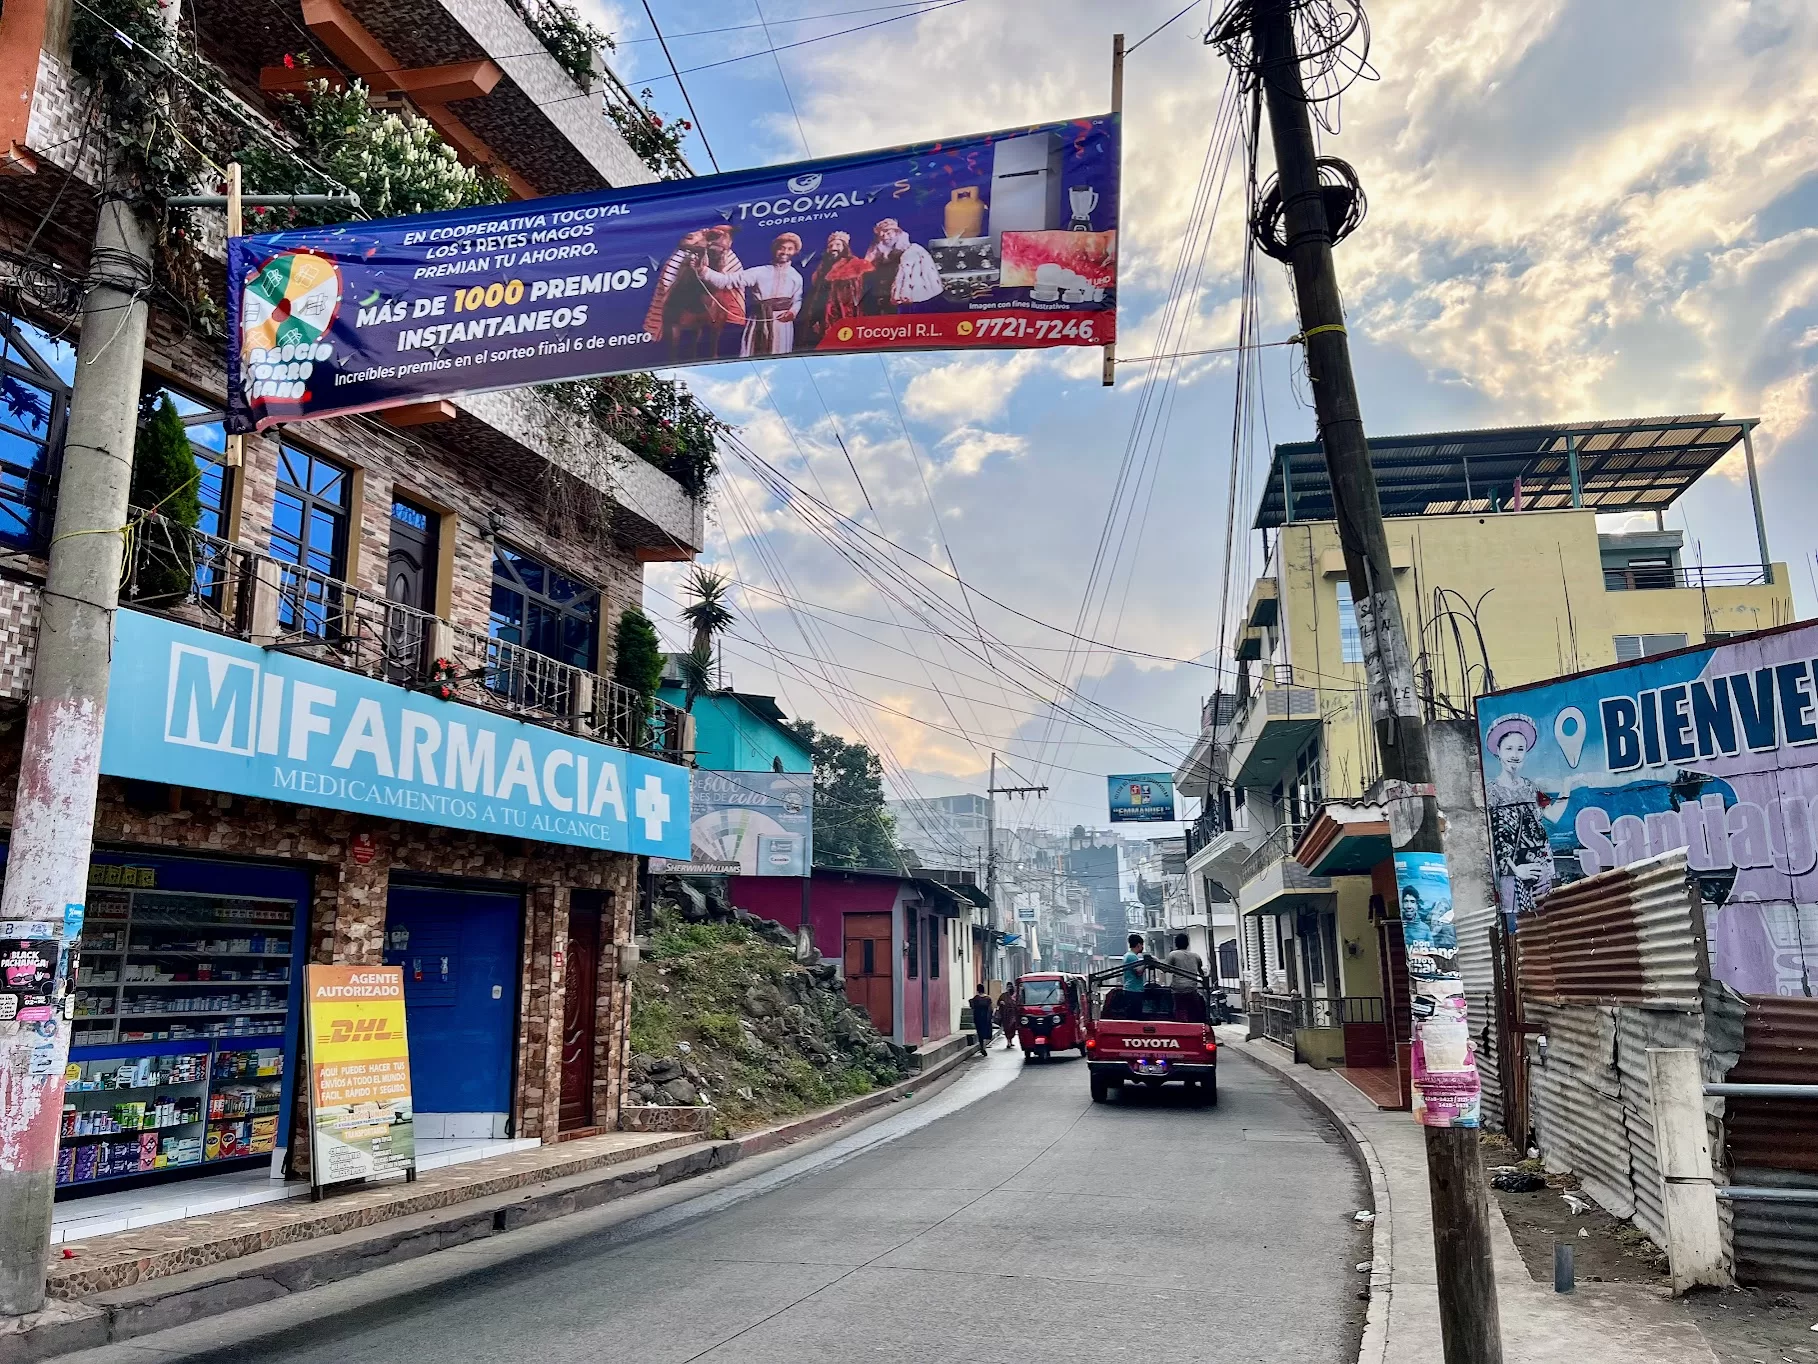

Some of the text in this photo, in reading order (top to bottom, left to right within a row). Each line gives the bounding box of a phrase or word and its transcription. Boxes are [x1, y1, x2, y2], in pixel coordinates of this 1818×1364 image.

[737, 189, 866, 221] TOCOYAL
[757, 210, 839, 228] COOPERATIVA
[403, 203, 631, 246] EN COOPERATIVA TOCOYAL
[425, 223, 597, 260] LOS 3 REYES MAGOS
[413, 242, 599, 280] PREMIAN TU AHORRO.
[356, 267, 650, 328] MÁS DE 1000 PREMIOS
[969, 299, 1071, 311] Imagen con fines ilustrativos
[396, 304, 589, 352] INSTANTANEOS
[856, 323, 943, 341] Tocoyal R.L.
[975, 316, 1095, 340] 7721-7246
[334, 331, 653, 387] Increíbles premios en el sorteo final 6 de enero
[1599, 658, 1818, 774] BIENVE
[164, 641, 628, 823] MIFARMACIA
[271, 765, 612, 842] MEDICAMENTOS A TU ALCANCE
[1575, 792, 1818, 877] Santiag
[316, 985, 400, 997] AUTORIZADO
[349, 973, 399, 985] AGENTE
[330, 1018, 393, 1043] DHL
[1121, 1038, 1180, 1048] TOYOTA
[341, 1064, 366, 1075] PUEDES
[369, 1063, 391, 1073] HACER
[394, 1061, 405, 1070] TUS
[347, 1079, 353, 1087] A
[354, 1075, 373, 1085] TODO
[373, 1075, 381, 1084] EL
[372, 1087, 378, 1095] Y
